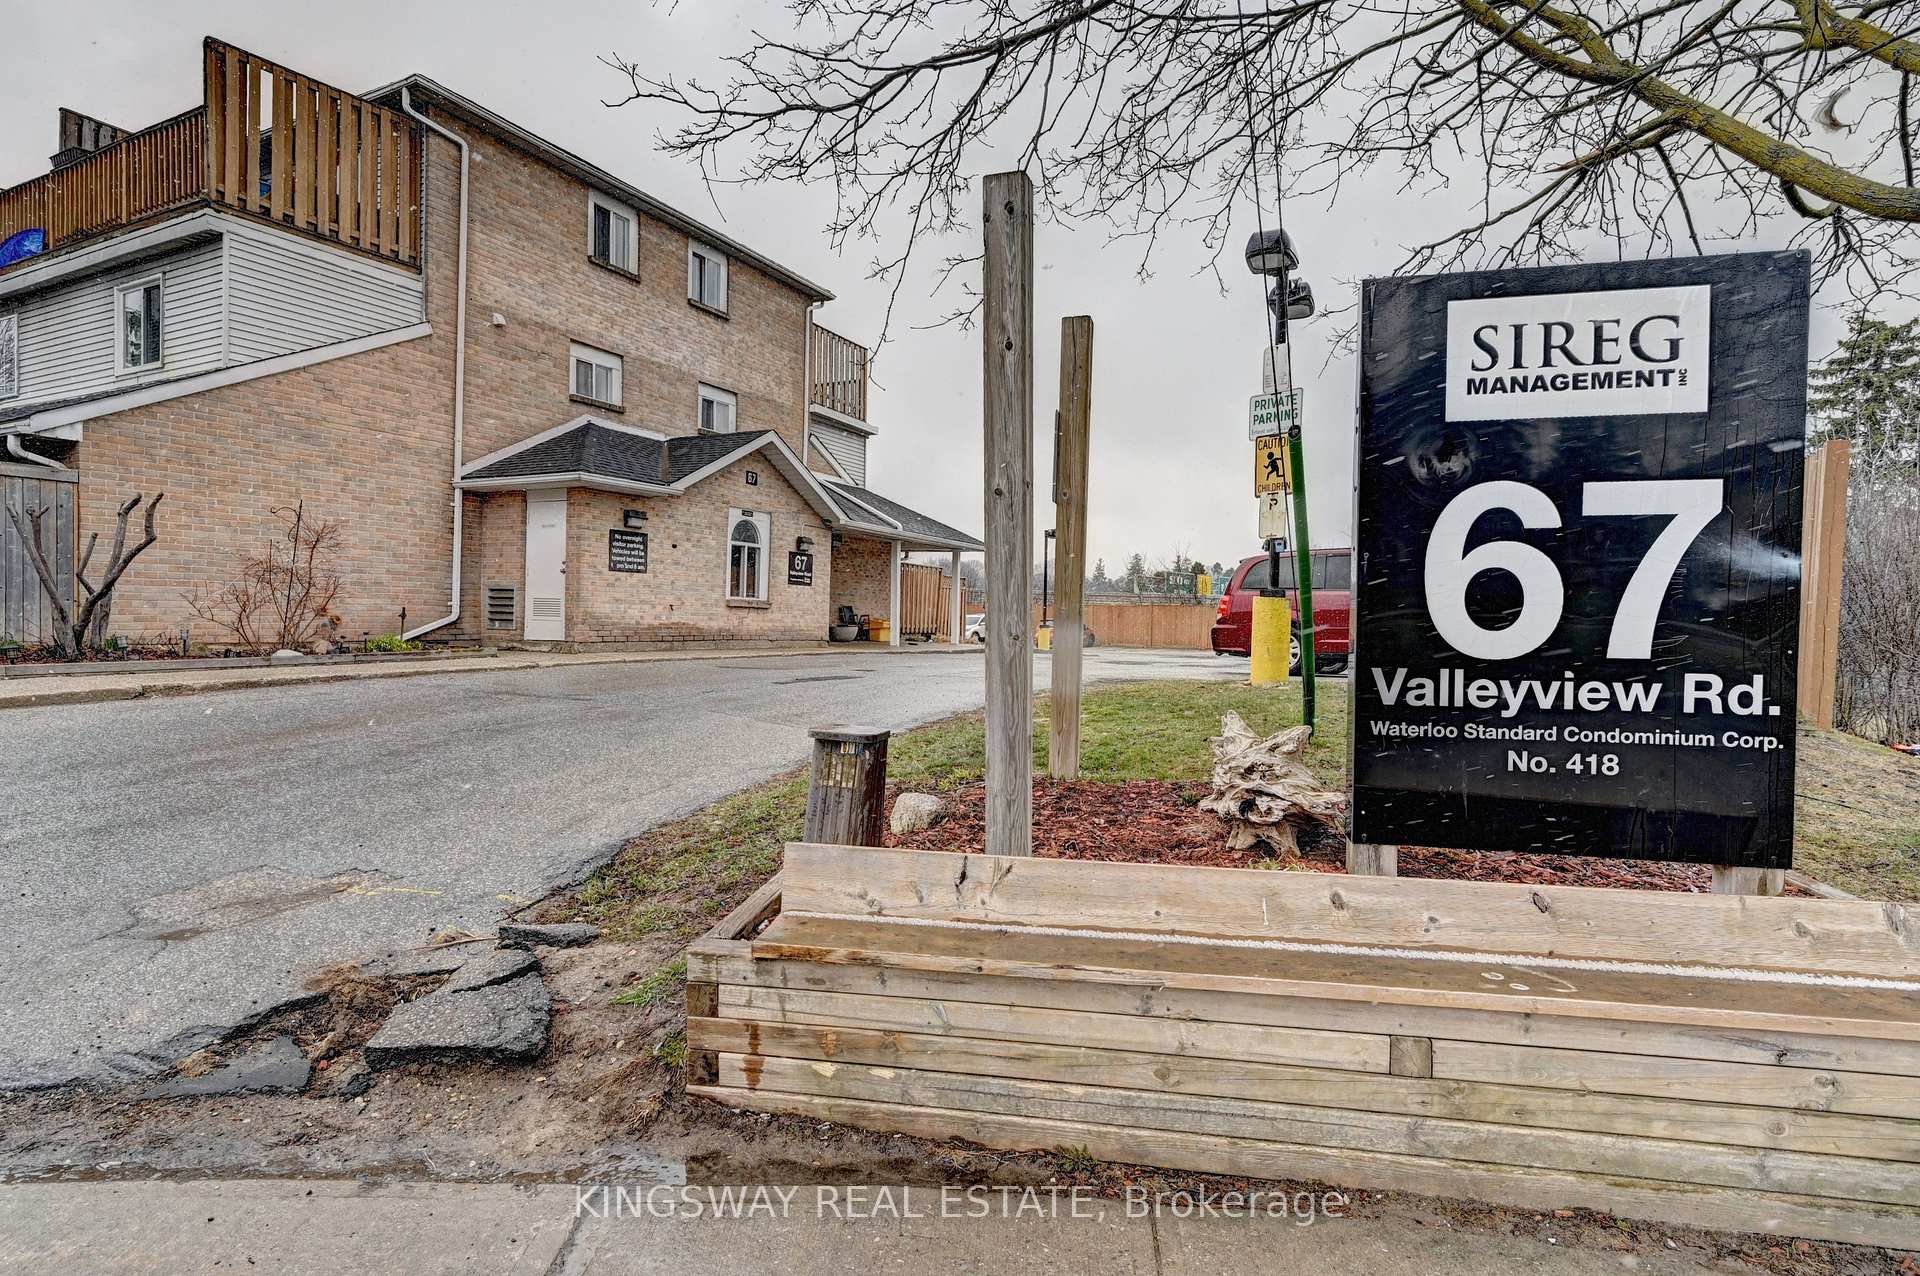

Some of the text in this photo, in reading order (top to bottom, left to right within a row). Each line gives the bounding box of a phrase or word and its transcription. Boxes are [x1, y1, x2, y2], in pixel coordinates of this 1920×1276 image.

[1470, 314, 1685, 372] SIREG
[1466, 367, 1688, 396] MANAGEMENT INC
[1254, 392, 1298, 411] PRIVATE
[747, 472, 756, 484] 67
[1257, 481, 1291, 493] CHILDREN
[794, 555, 808, 570] 67
[1424, 479, 1724, 660] 67
[1371, 667, 1782, 718] Valleyview Rd.
[1370, 720, 1785, 751] Waterloo Standard Condominium Corp.
[1506, 750, 1621, 776] No. 418
